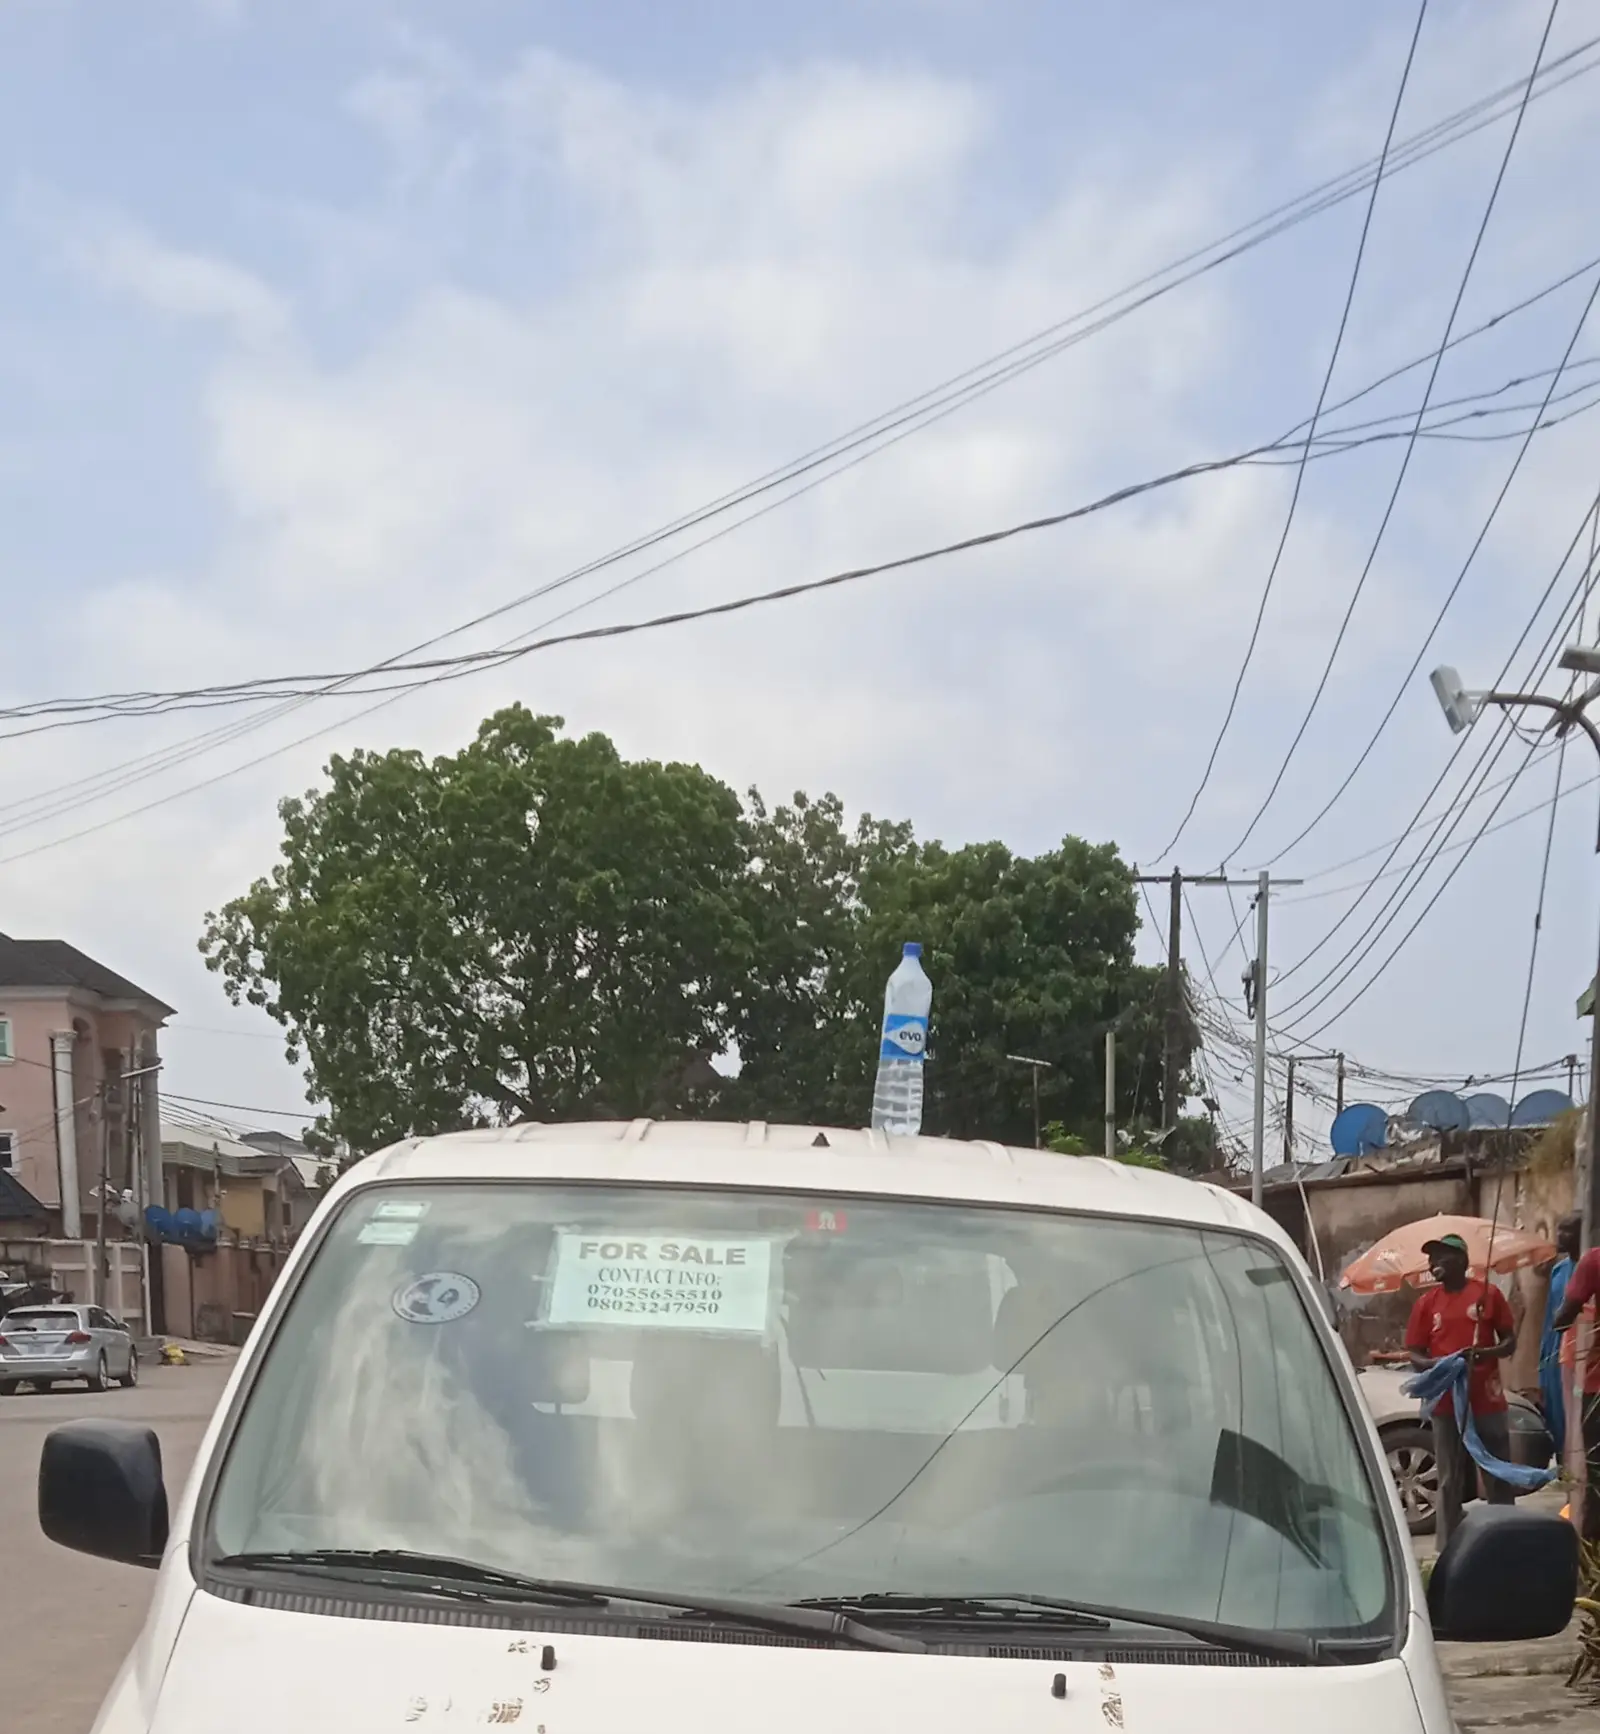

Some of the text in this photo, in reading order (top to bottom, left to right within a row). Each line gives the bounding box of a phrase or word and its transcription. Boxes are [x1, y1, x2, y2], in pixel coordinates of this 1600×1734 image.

[579, 1242, 746, 1265] FOR SALE
[598, 1267, 722, 1286] CONTACT INFO:
[587, 1284, 722, 1300] 07055655510
[587, 1297, 719, 1314] 08023247950
